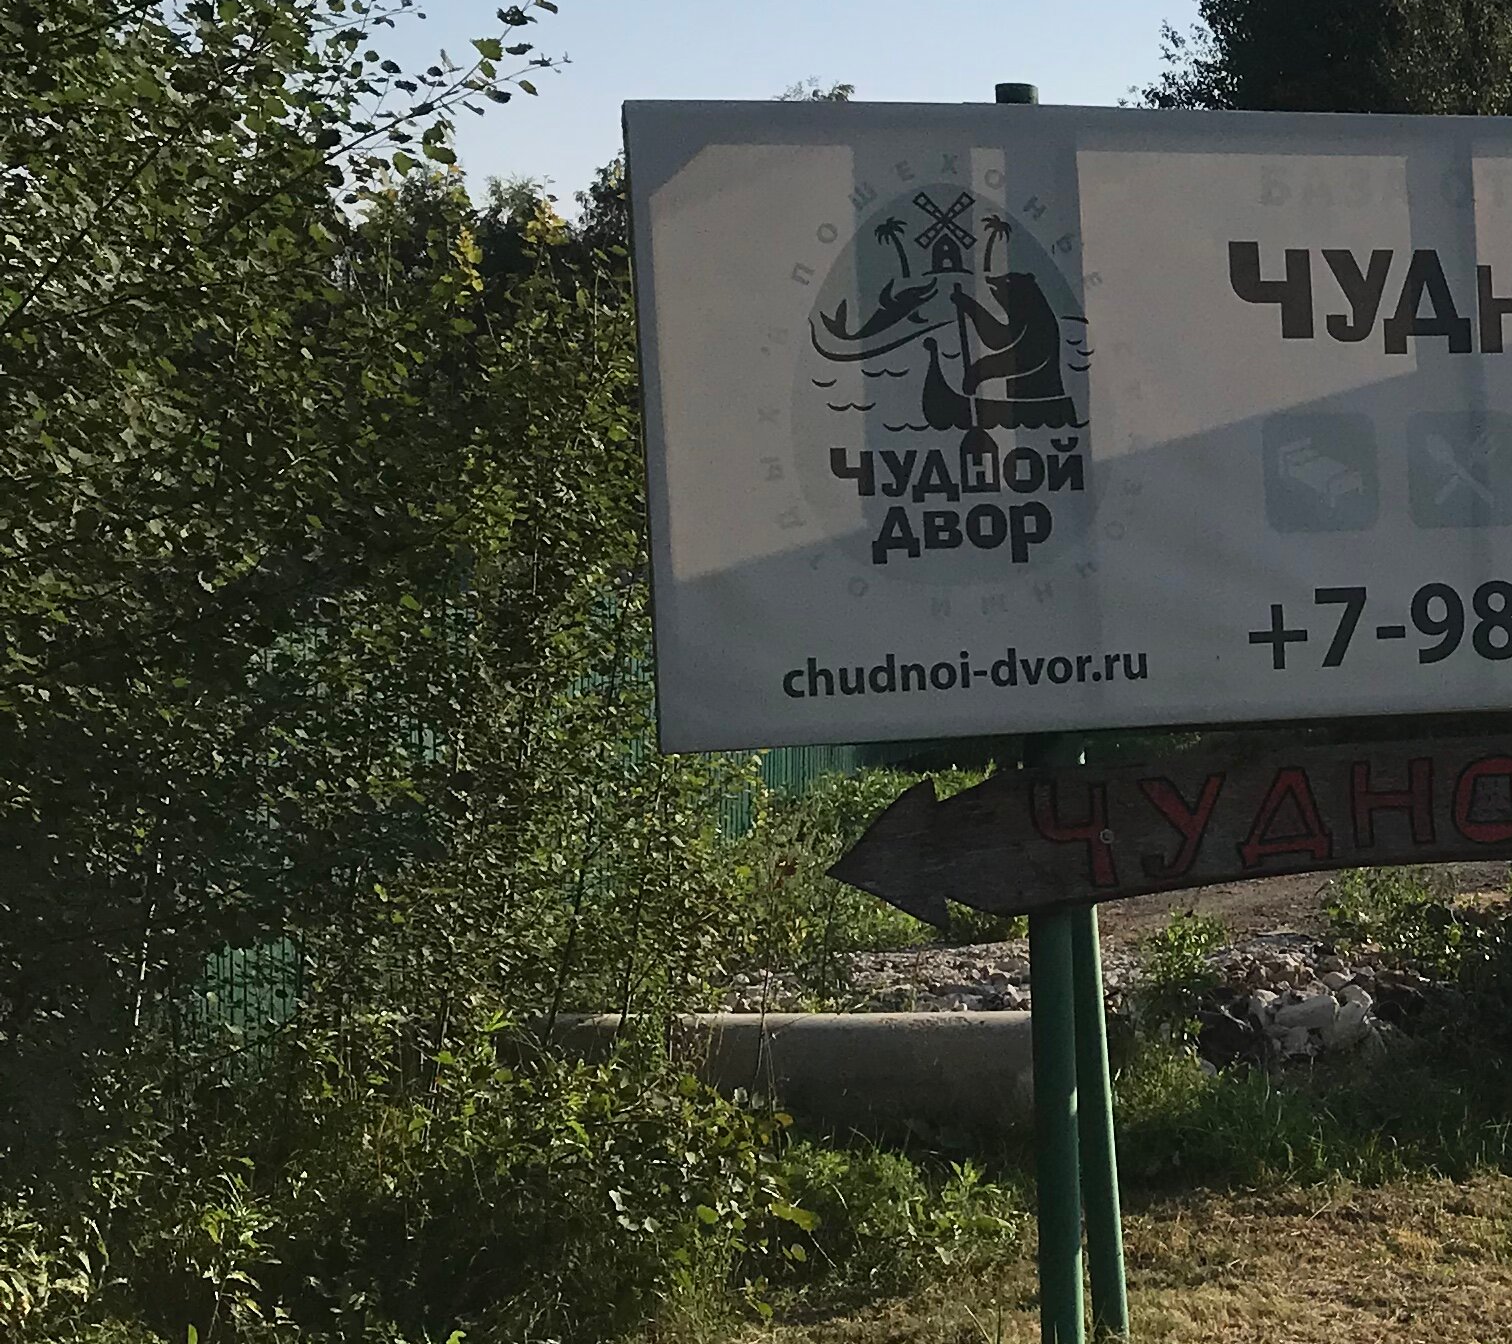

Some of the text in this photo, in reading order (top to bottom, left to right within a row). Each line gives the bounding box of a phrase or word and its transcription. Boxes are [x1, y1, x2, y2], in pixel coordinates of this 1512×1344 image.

[791, 153, 1103, 288] ПОШЕХОНЬЕ
[829, 436, 1085, 504] ЧУДНОЙ
[872, 499, 1053, 565] ДВОР
[782, 648, 1148, 699] chudnoi-dvor.ru
